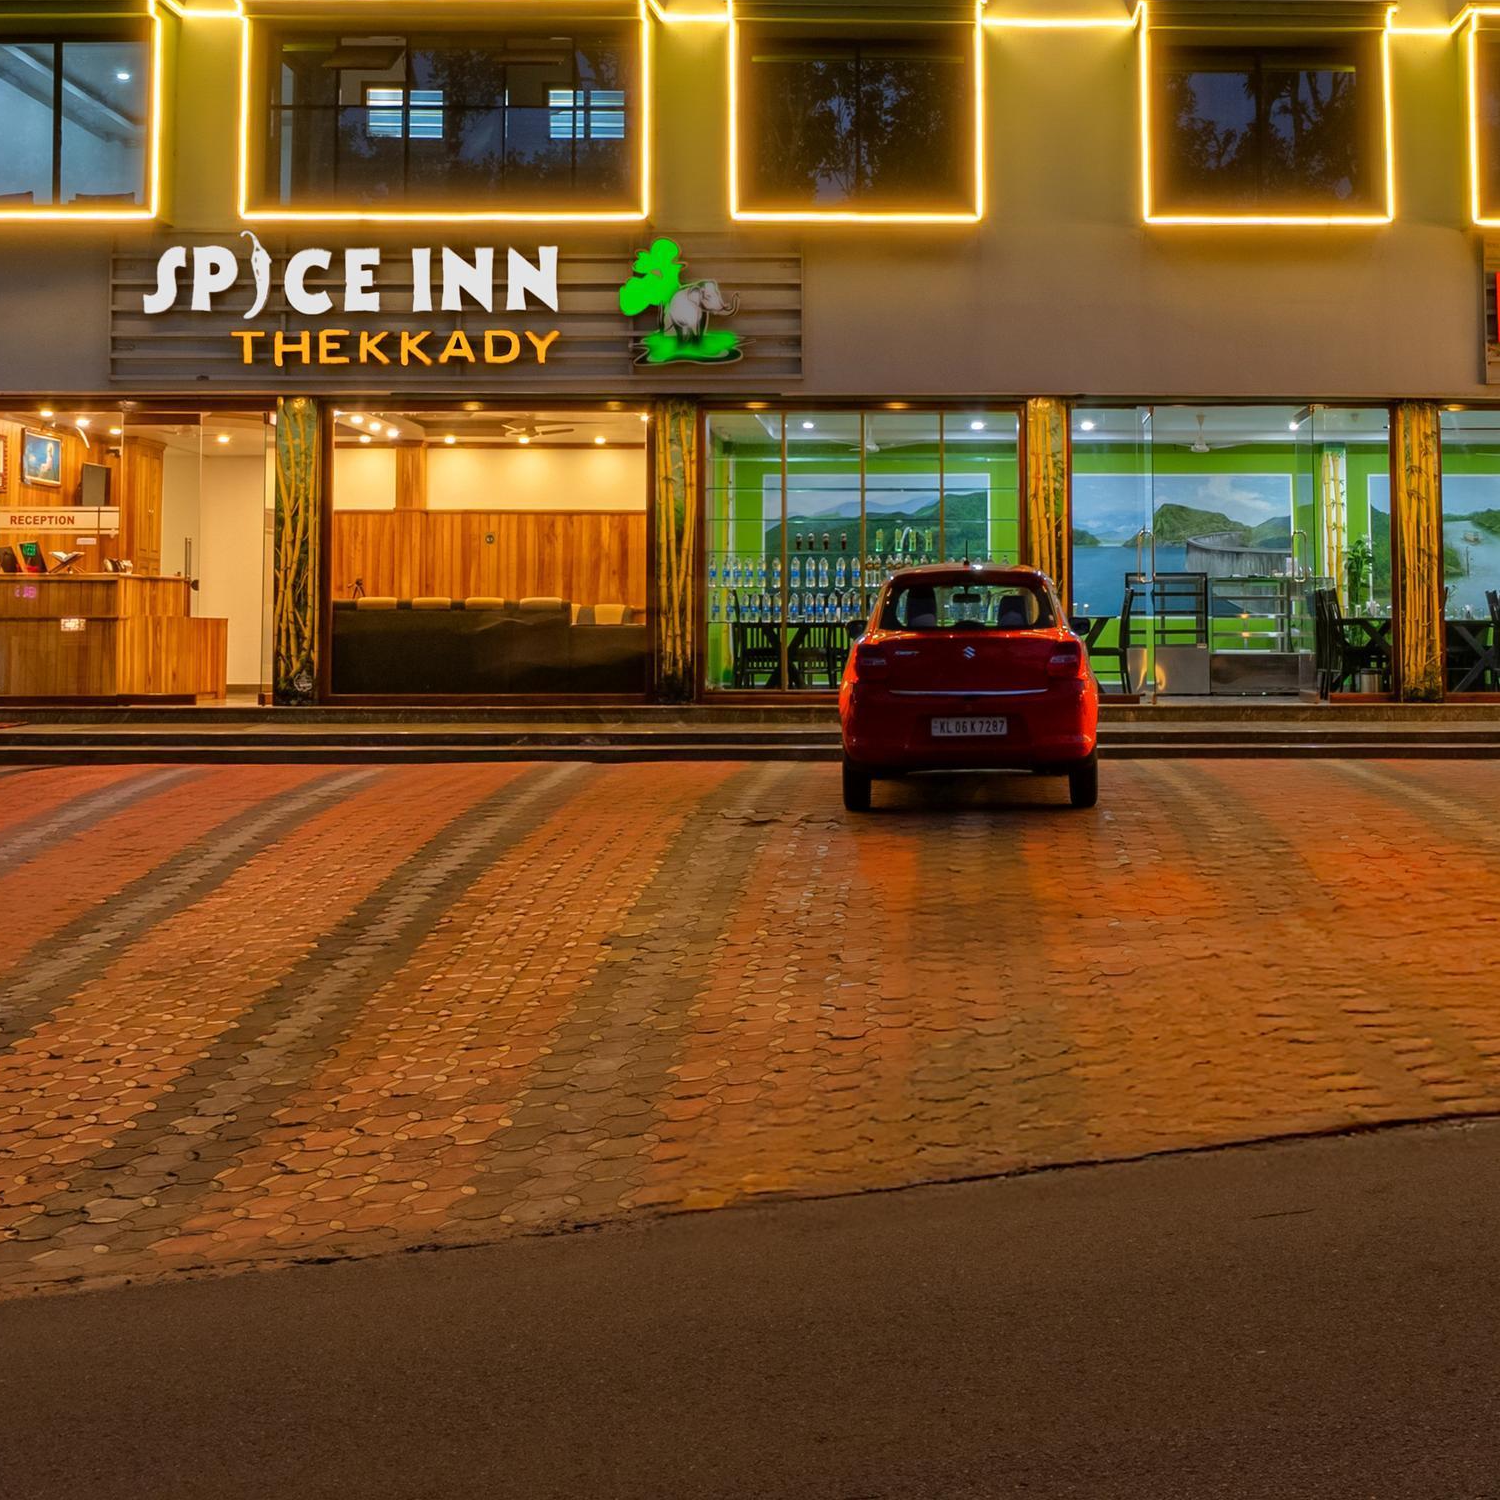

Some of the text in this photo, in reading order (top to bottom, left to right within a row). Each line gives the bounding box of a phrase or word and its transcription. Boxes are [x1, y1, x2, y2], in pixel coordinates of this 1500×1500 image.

[143, 230, 559, 319] SPICE INN
[231, 329, 561, 367] THEKKADY
[10, 515, 75, 525] RECEPTION
